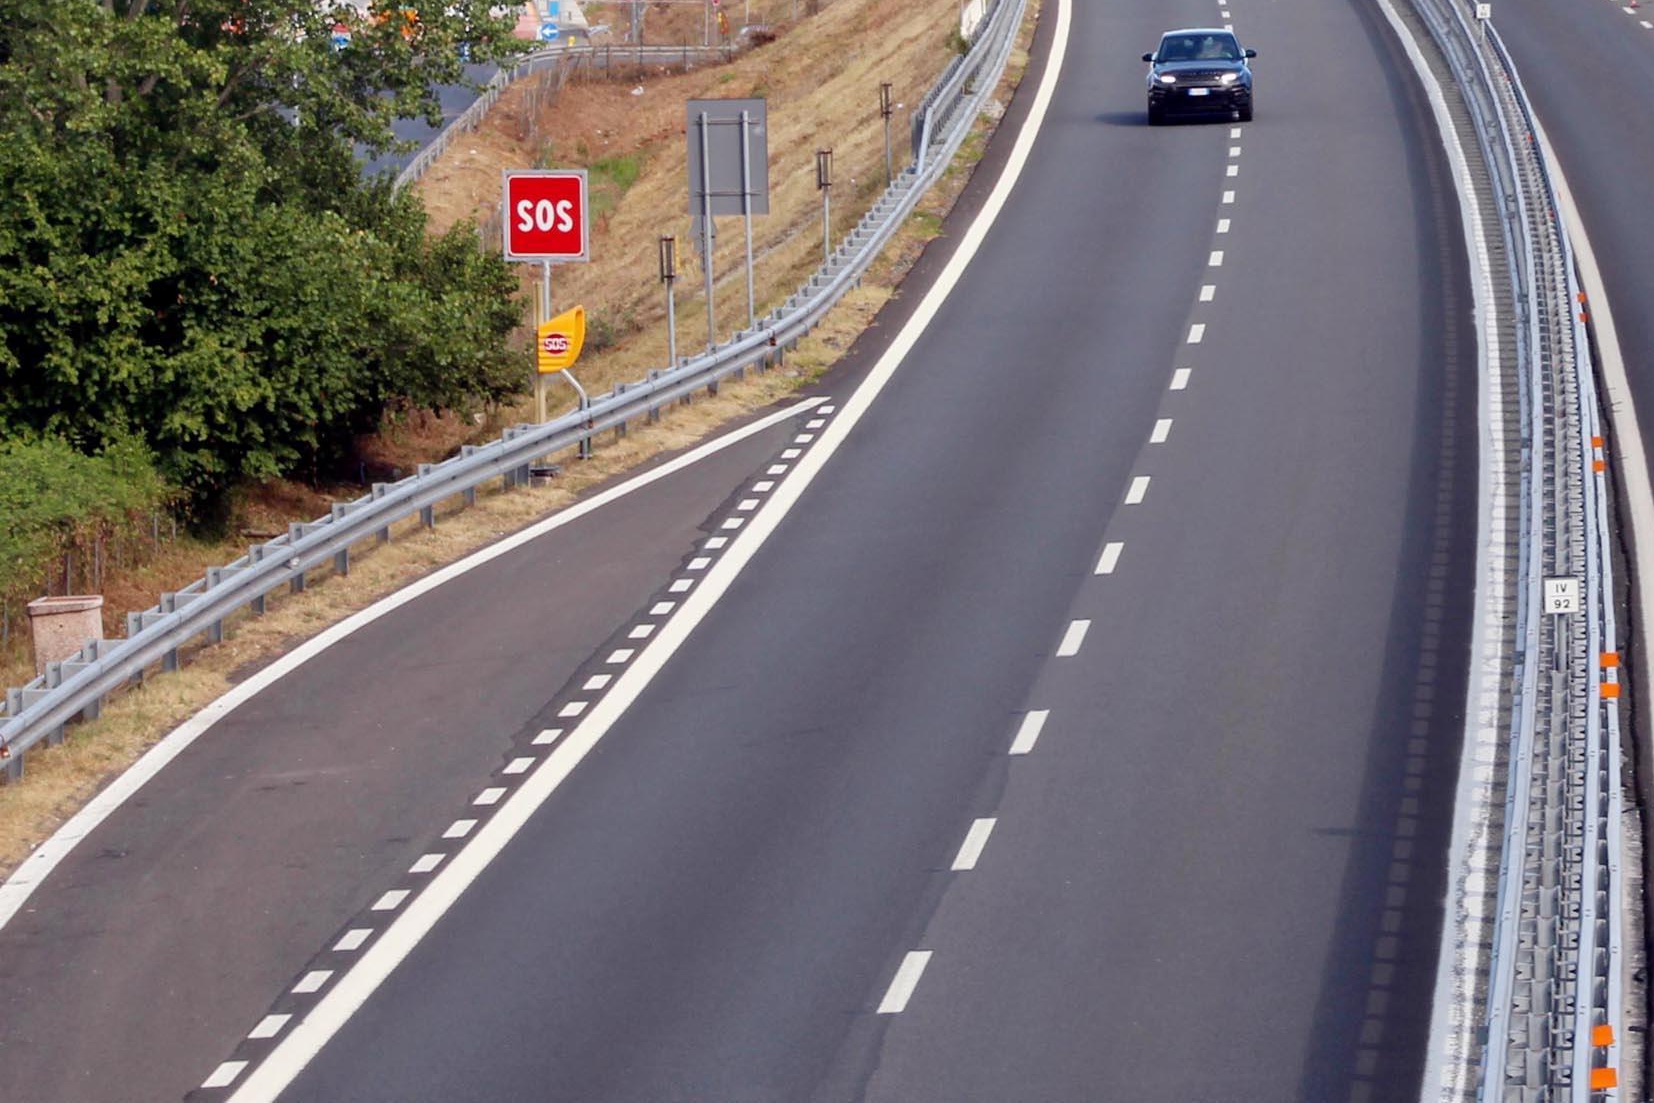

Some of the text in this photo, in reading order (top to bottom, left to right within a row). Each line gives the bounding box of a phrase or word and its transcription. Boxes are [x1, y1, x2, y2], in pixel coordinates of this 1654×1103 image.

[517, 199, 573, 232] SOS
[544, 337, 568, 351] SOS
[1555, 583, 1567, 593] IV
[1554, 599, 1570, 608] 92
